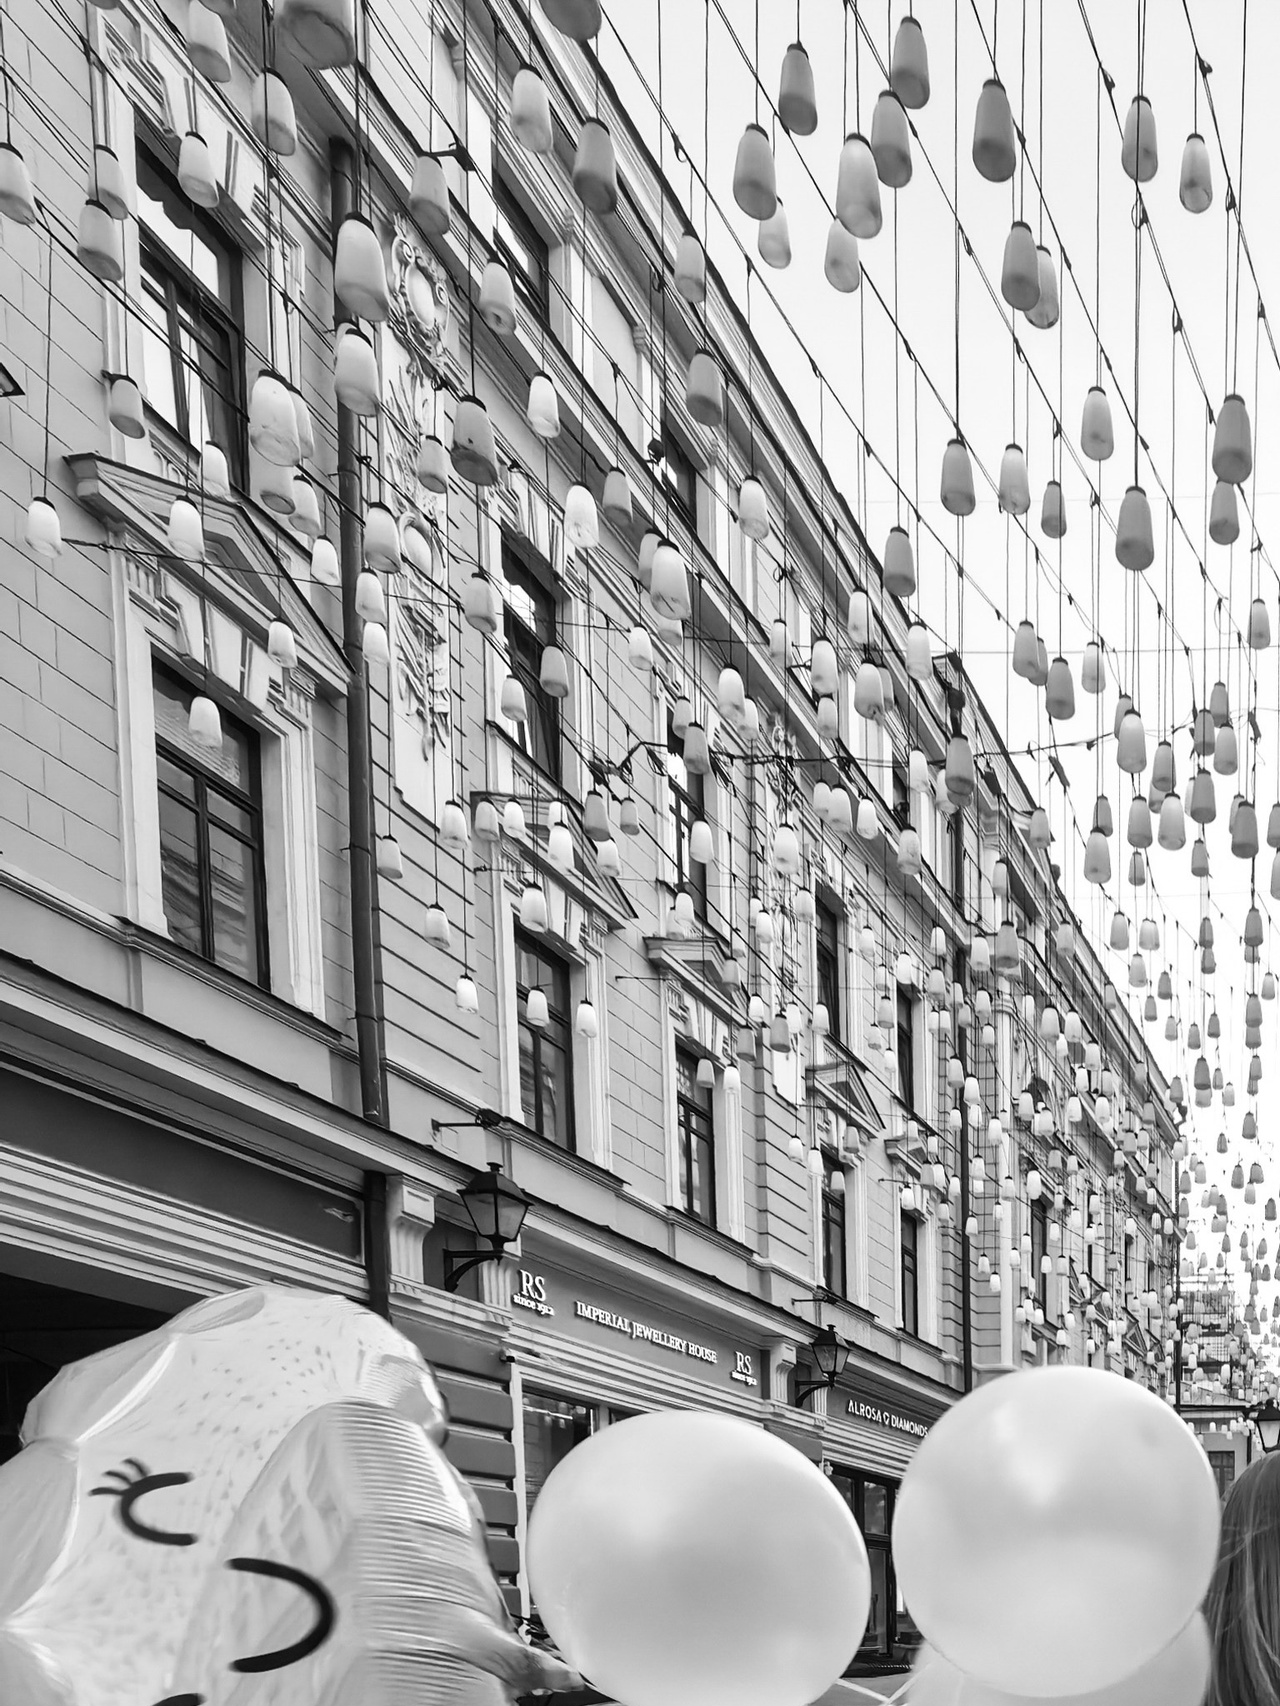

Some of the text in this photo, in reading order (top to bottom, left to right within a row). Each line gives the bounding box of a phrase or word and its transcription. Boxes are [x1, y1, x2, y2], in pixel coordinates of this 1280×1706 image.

[513, 1293, 537, 1310] since
[520, 1269, 546, 1302] RS
[576, 1300, 718, 1364] IMPERIAL JEWELLERY HOUSE
[735, 1350, 752, 1375] RS
[848, 1399, 928, 1438] ALROSA DIAMONDS
